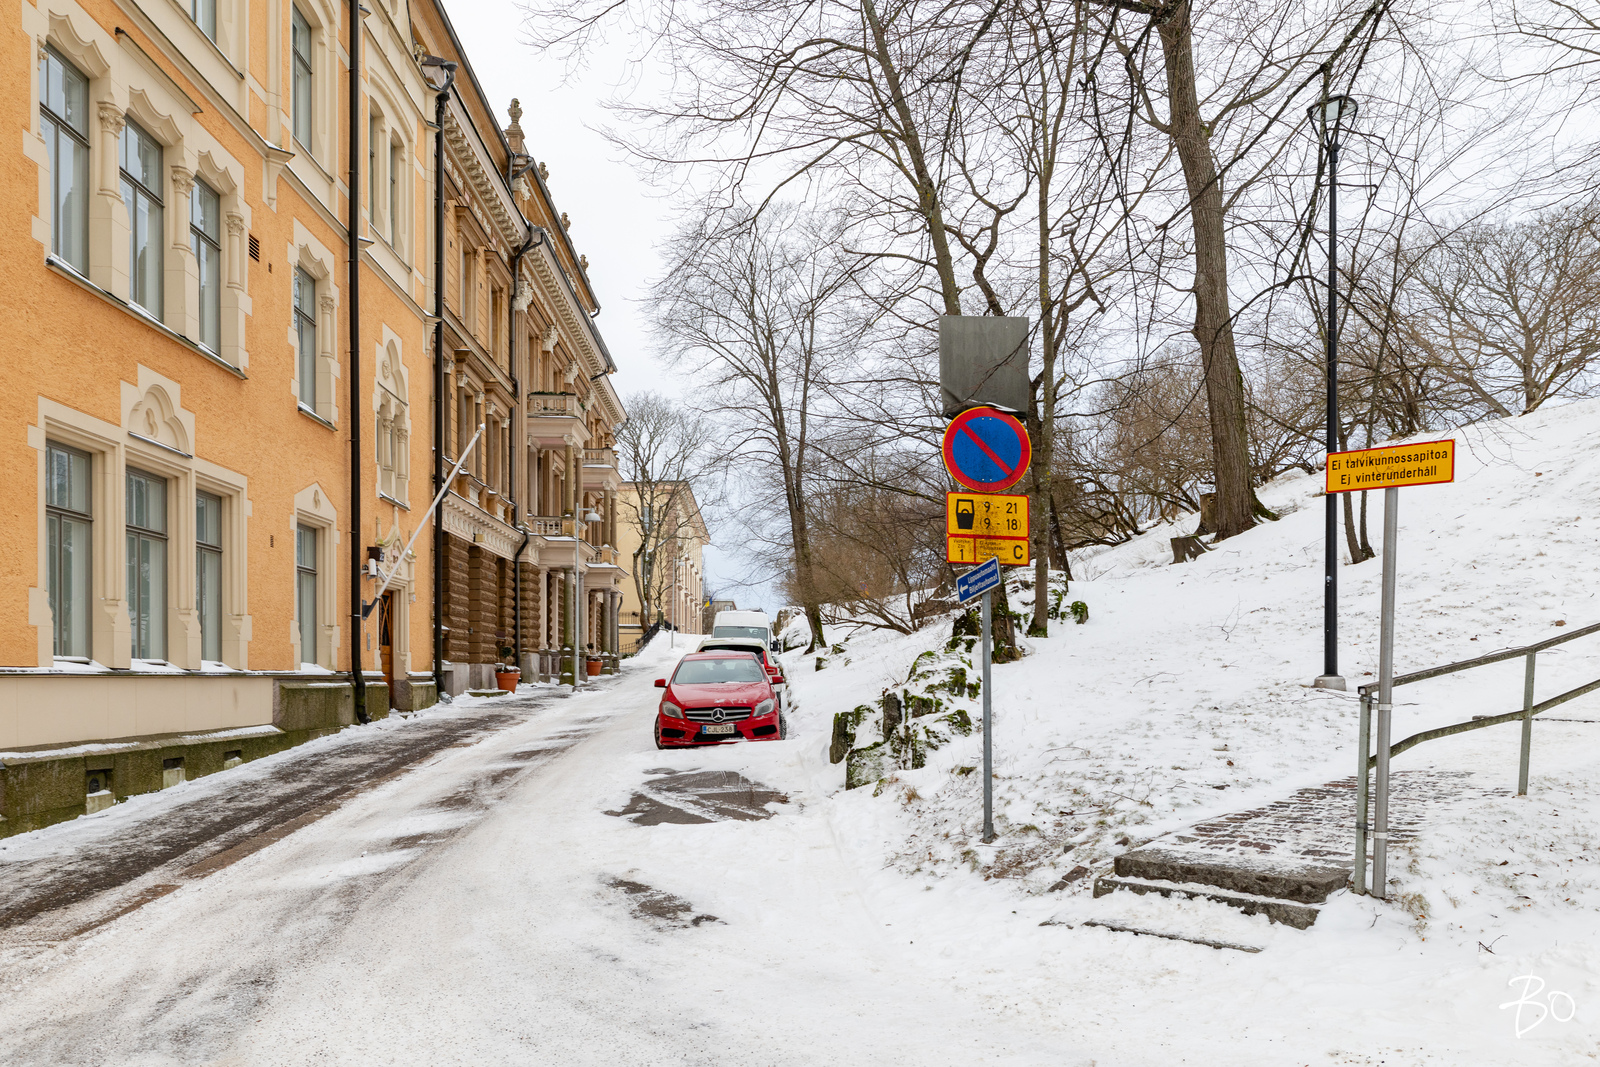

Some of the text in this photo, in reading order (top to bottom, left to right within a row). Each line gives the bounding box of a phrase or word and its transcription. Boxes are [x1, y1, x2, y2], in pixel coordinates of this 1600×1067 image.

[1331, 449, 1448, 471] Ei talvikunnossapitoa
[1340, 464, 1437, 486] Ej vinterunderhåll
[983, 501, 991, 513] 9
[1005, 502, 1017, 514] 21
[1005, 518, 1022, 531] 18)
[959, 548, 964, 561] 1
[1013, 544, 1024, 560] C
